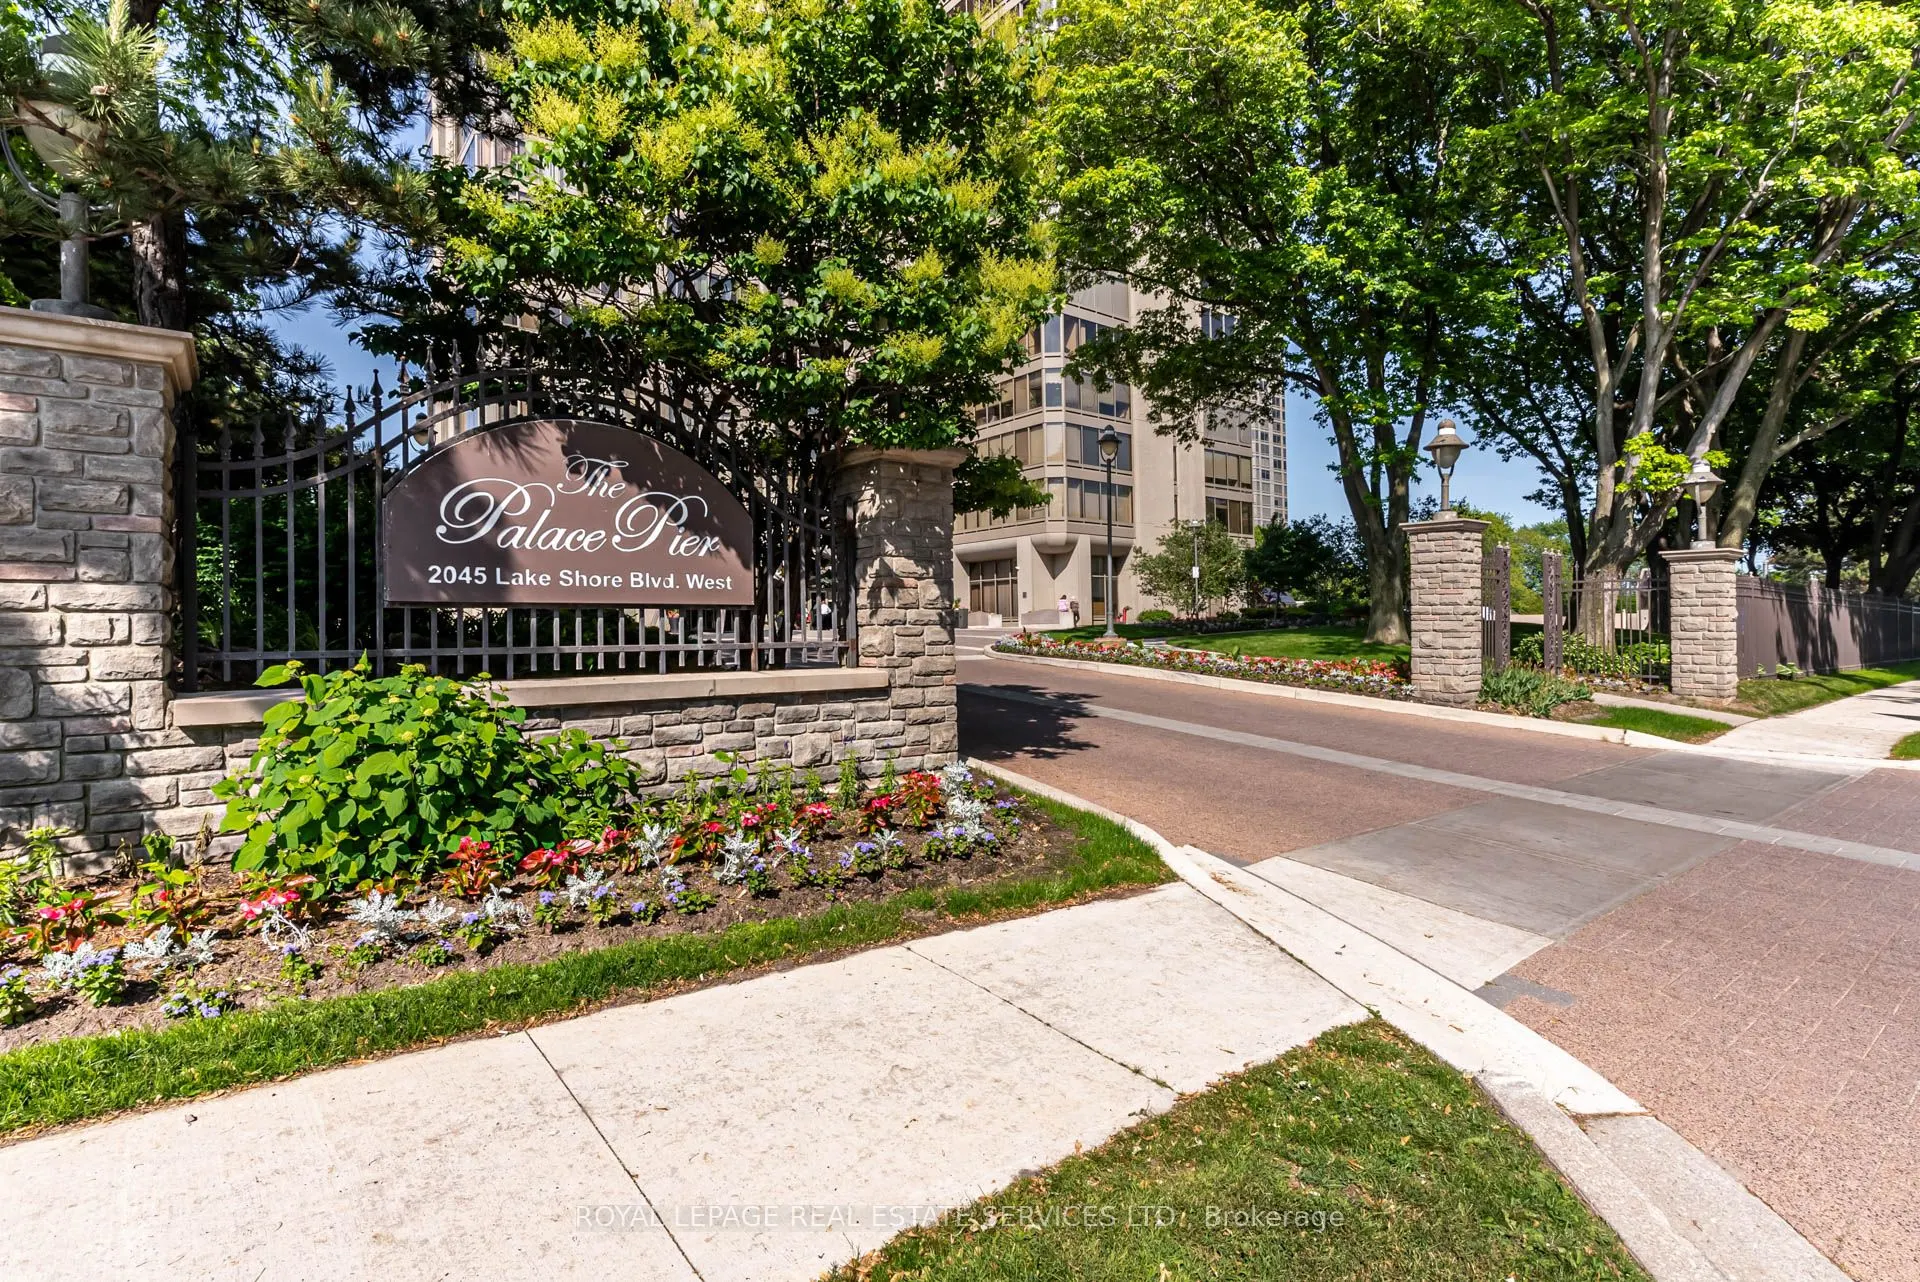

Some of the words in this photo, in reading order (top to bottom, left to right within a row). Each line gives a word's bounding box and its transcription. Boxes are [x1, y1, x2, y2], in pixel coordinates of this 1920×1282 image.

[556, 454, 629, 499] The
[435, 477, 606, 552] Palace
[611, 491, 721, 557] Pier
[428, 565, 487, 585] 2045
[496, 568, 551, 587] Lake
[559, 569, 623, 589] Shore
[630, 572, 680, 590] Blvd.
[686, 573, 733, 590] West
